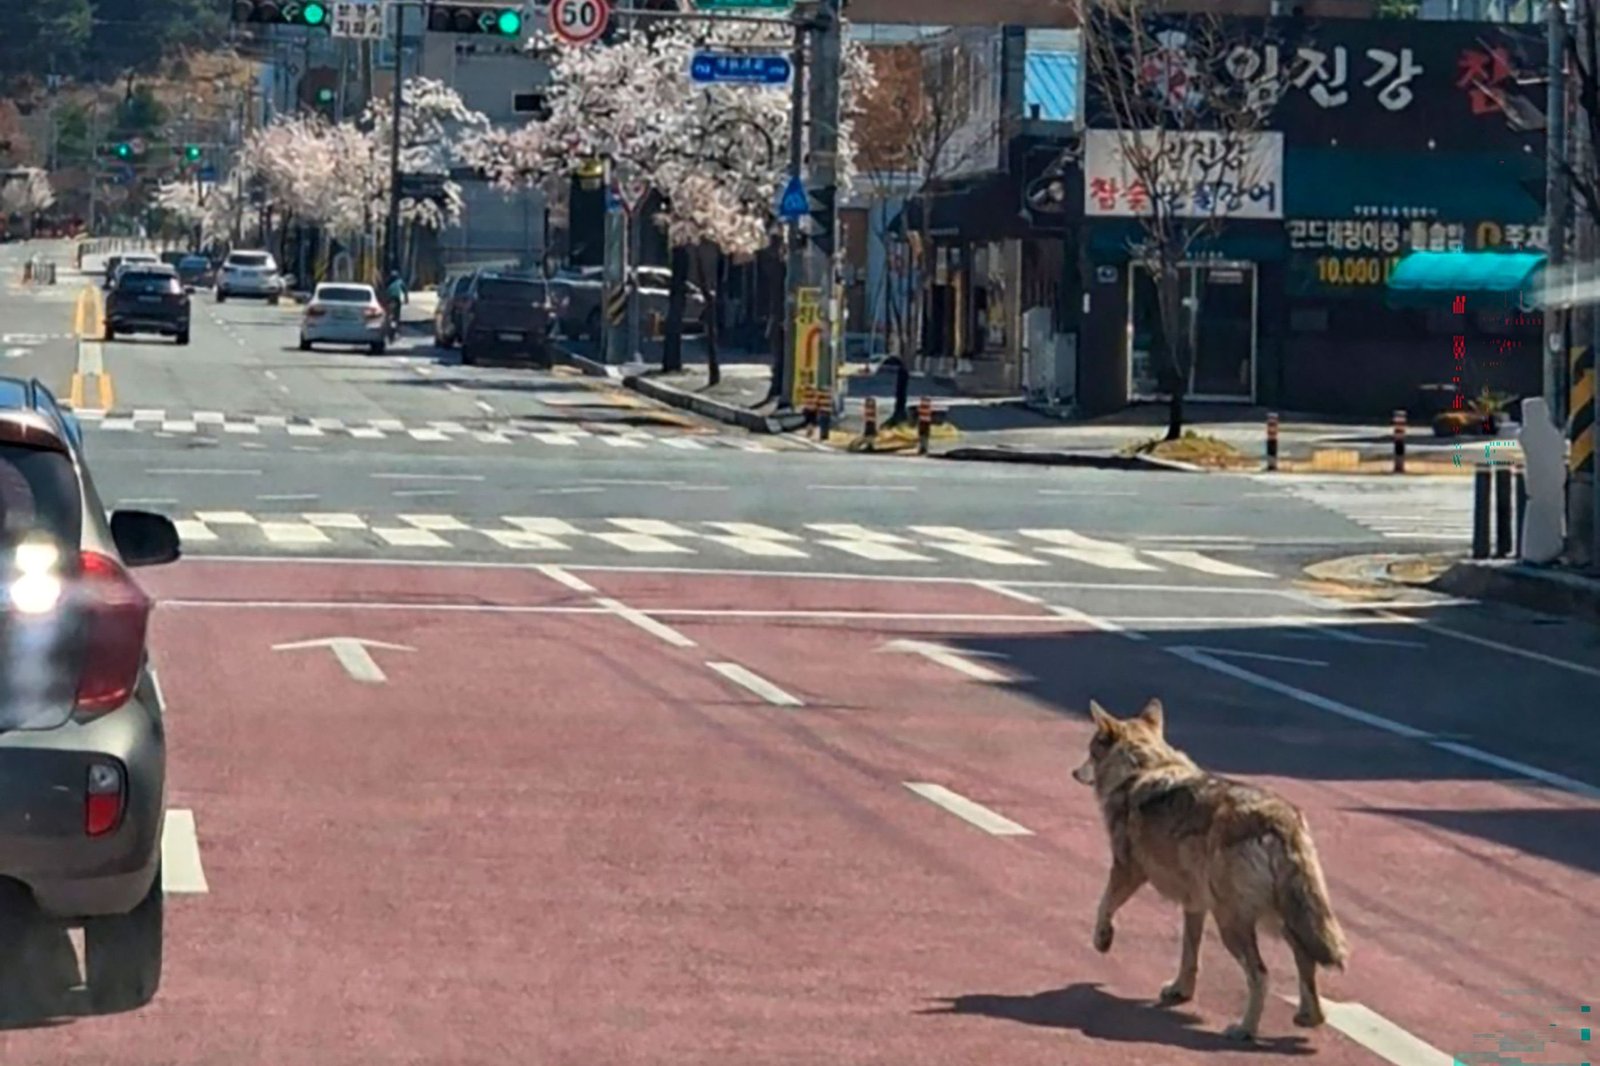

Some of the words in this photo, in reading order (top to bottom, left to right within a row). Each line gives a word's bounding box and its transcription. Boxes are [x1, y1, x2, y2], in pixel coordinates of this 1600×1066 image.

[562, 0, 597, 27] 50
[1225, 46, 1424, 112] 임진강
[1317, 256, 1380, 285] 10,000
